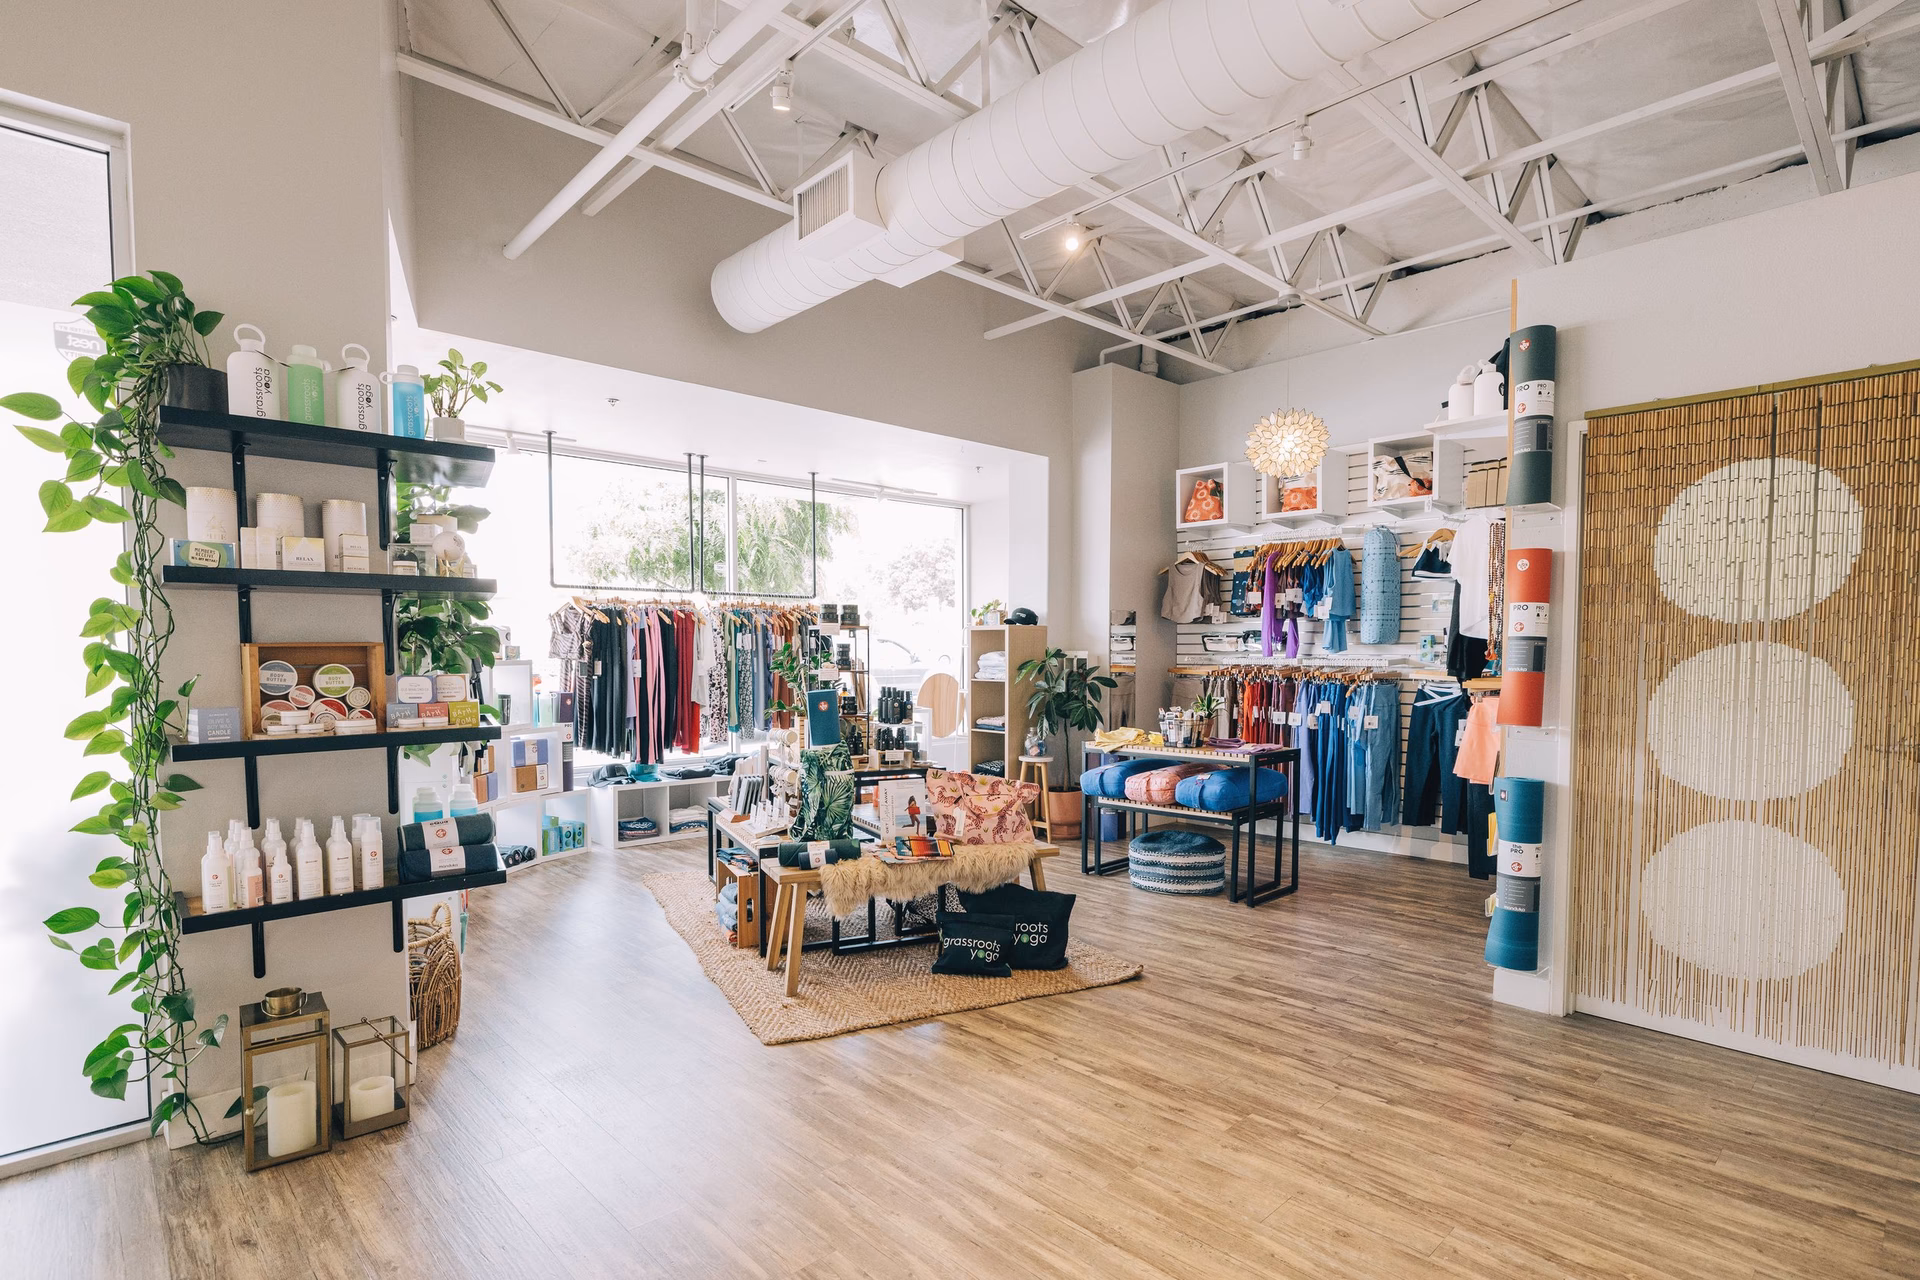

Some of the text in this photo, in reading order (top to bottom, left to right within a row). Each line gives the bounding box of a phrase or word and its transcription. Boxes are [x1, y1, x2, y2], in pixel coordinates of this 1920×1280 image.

[264, 368, 272, 395] yoga
[1516, 383, 1530, 392] PRO
[253, 367, 266, 417] grassroots
[365, 384, 373, 409] yoga
[302, 378, 314, 422] grassroots
[356, 383, 367, 430] grassroots
[406, 395, 416, 436] grassroots
[391, 709, 411, 719] BATH
[421, 709, 441, 718] BATH
[452, 707, 472, 717] BATH
[456, 717, 477, 727] BOMB
[943, 937, 1001, 952] grassroots
[1013, 933, 1048, 947] yoga
[970, 949, 1000, 962] yoga
